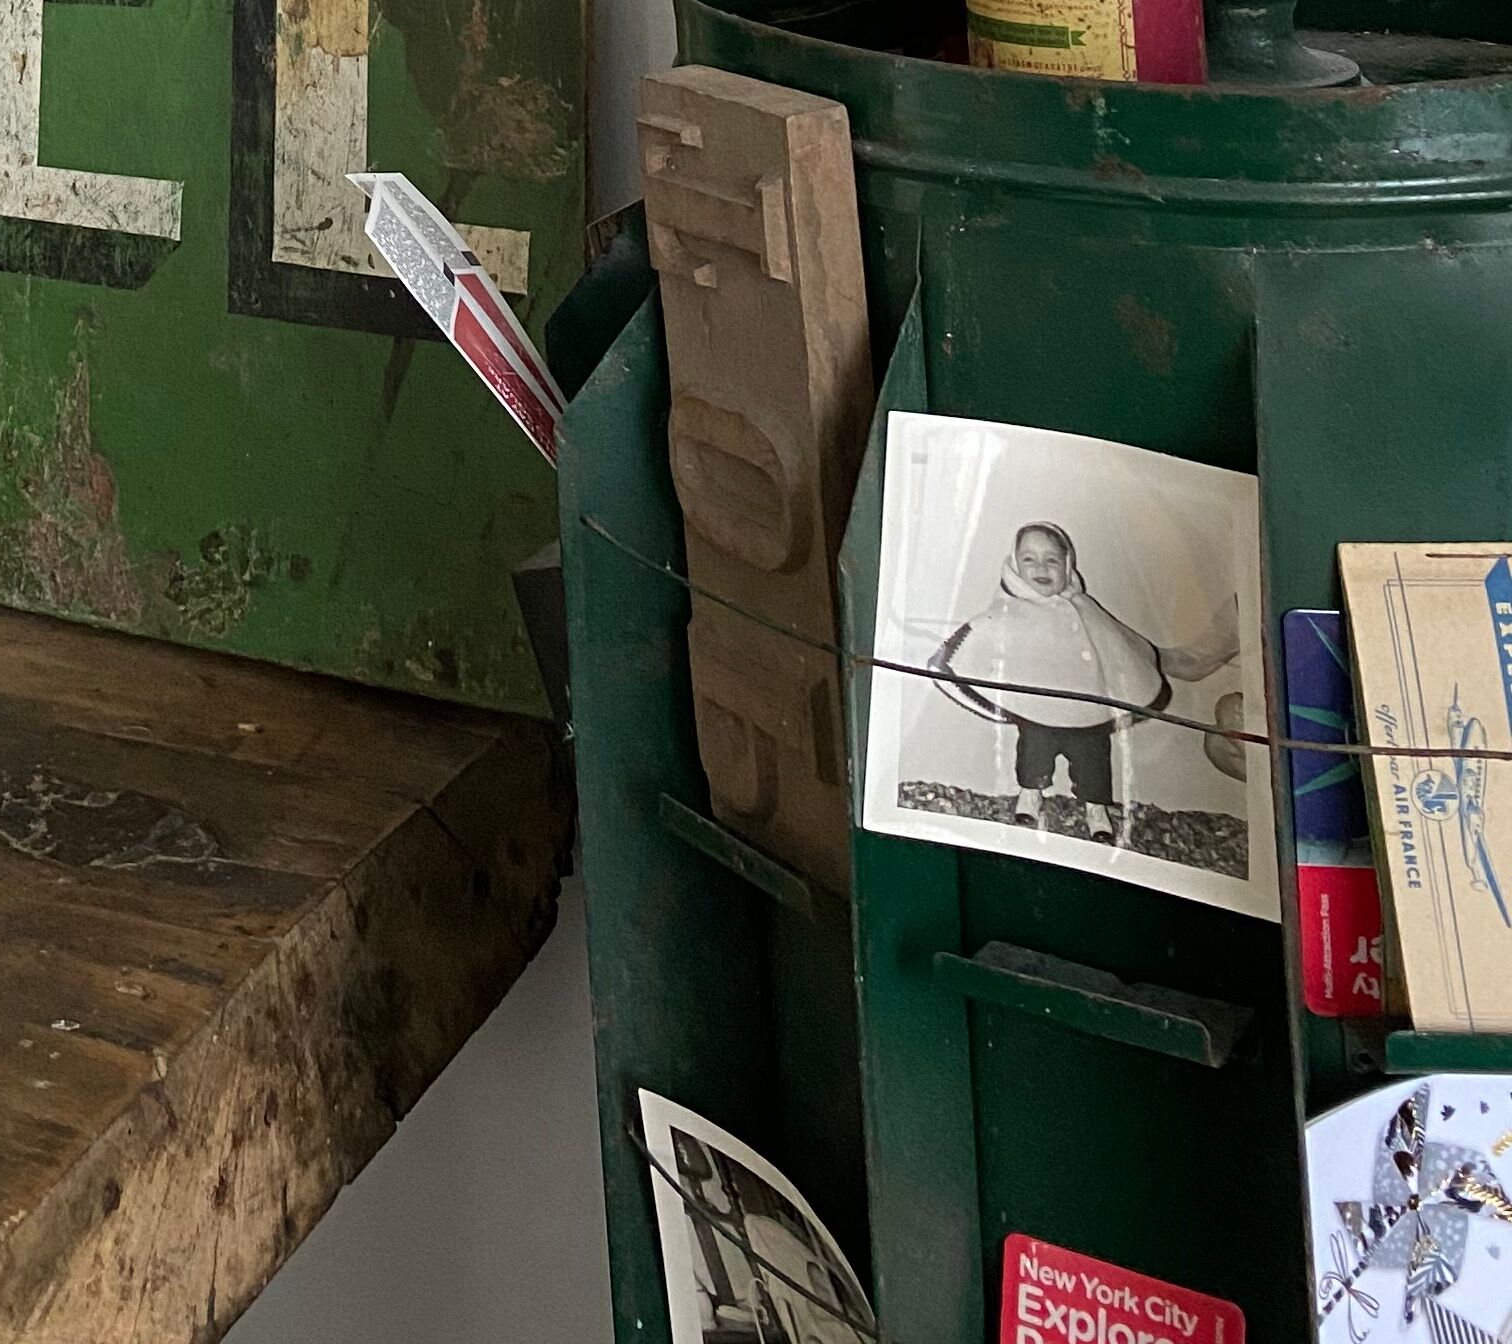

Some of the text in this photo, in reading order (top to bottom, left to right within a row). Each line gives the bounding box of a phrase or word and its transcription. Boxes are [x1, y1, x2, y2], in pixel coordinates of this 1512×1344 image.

[1393, 784, 1410, 814] AIR
[1399, 821, 1422, 889] FRANCE
[1019, 1252, 1077, 1293] New
[1080, 1272, 1140, 1315] York
[1143, 1295, 1199, 1337] City
